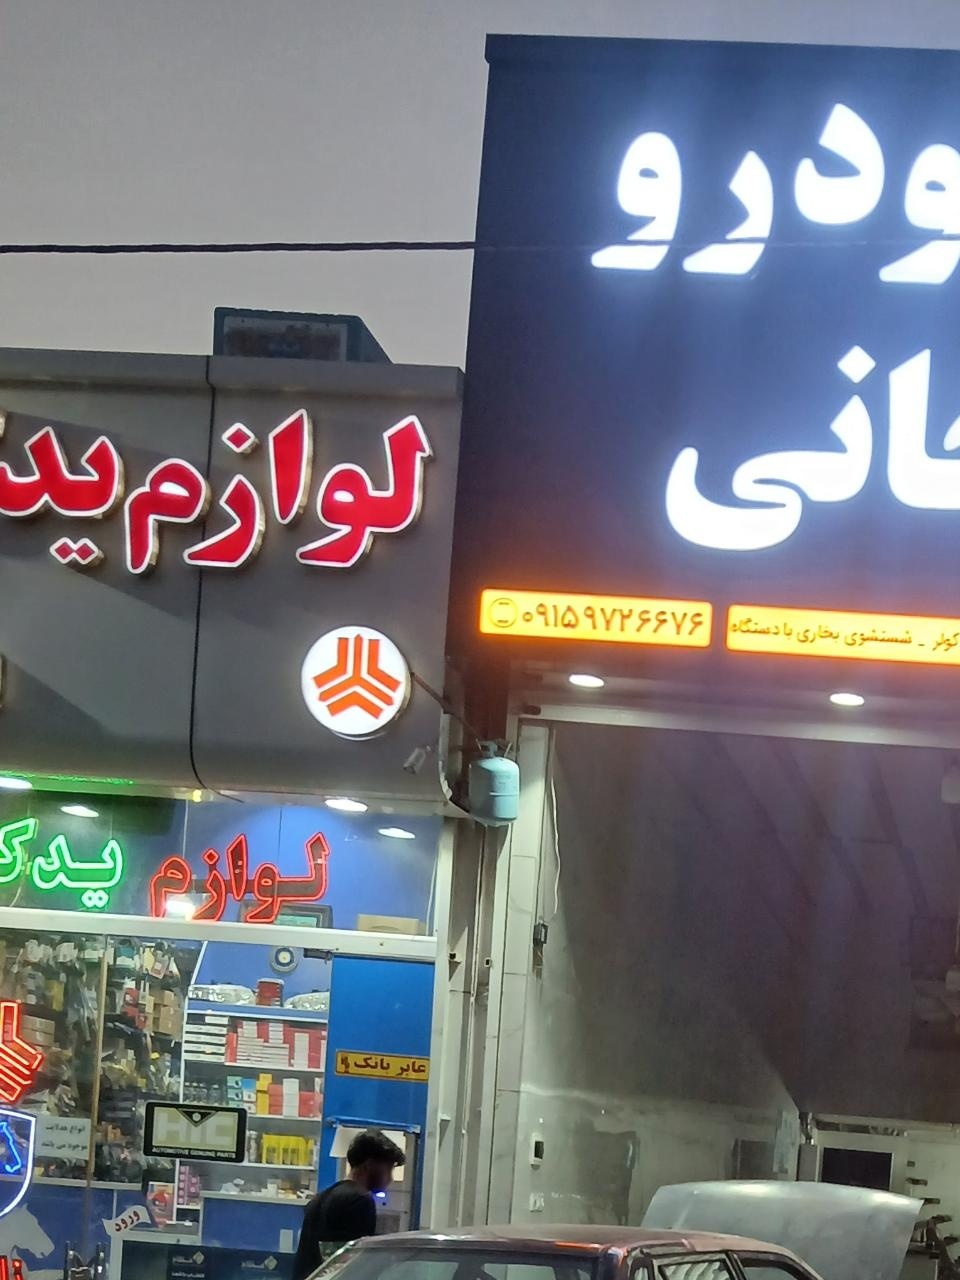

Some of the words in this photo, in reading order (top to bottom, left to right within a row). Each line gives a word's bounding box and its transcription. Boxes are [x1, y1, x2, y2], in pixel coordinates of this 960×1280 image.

[123, 408, 433, 574] لوازم
[521, 602, 704, 636] ۰۹۱۵۹۷۲۶۶۷۶
[729, 617, 781, 636] دستگاه
[783, 622, 793, 640] با
[796, 624, 840, 644] بخاری
[844, 629, 913, 647] شستشوی
[151, 832, 330, 923] لوازم
[353, 1055, 391, 1075] بانک
[394, 1060, 427, 1077] عابر
[114, 1209, 141, 1233] ورود
